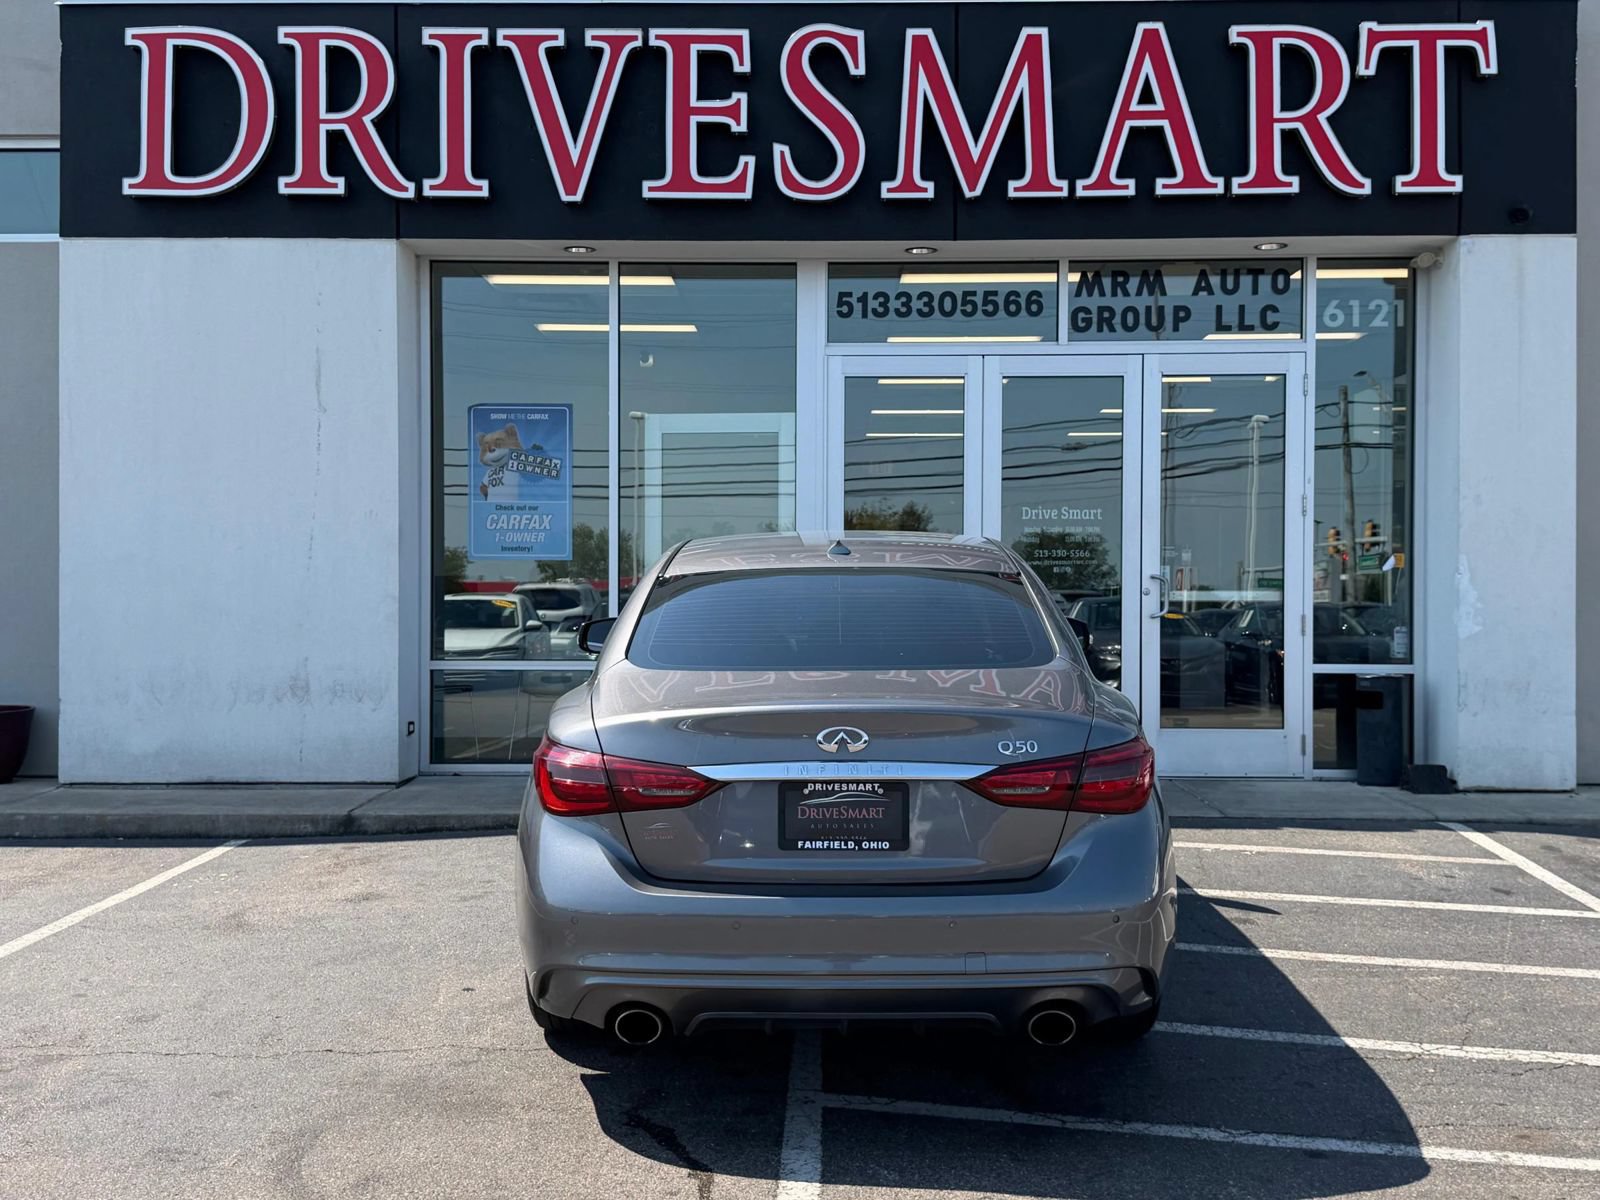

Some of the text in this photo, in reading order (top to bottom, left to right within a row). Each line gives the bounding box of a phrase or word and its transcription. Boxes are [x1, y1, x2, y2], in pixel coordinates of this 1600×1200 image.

[121, 20, 1498, 204] DRIVESMART
[1074, 268, 1291, 298] MRM AUTO
[836, 290, 1044, 319] 5133305566
[1070, 304, 1280, 333] GROUP LLC
[1322, 299, 1405, 328] 6121
[511, 451, 560, 469] CARFAX
[487, 465, 505, 478] CAR
[518, 463, 558, 477] OWNER
[487, 477, 505, 488] FOX
[1022, 506, 1103, 520] Drive Smart
[486, 513, 552, 530] CARFAX
[495, 532, 545, 543] 1-OWNER
[501, 545, 533, 553] Inventory!
[1033, 549, 1090, 558] 513-330-5566
[997, 740, 1038, 756] Q50
[783, 765, 905, 776] INFINITI
[807, 783, 880, 791] DRIVESMART
[797, 841, 890, 851] FAIRFIELD, OHIO
